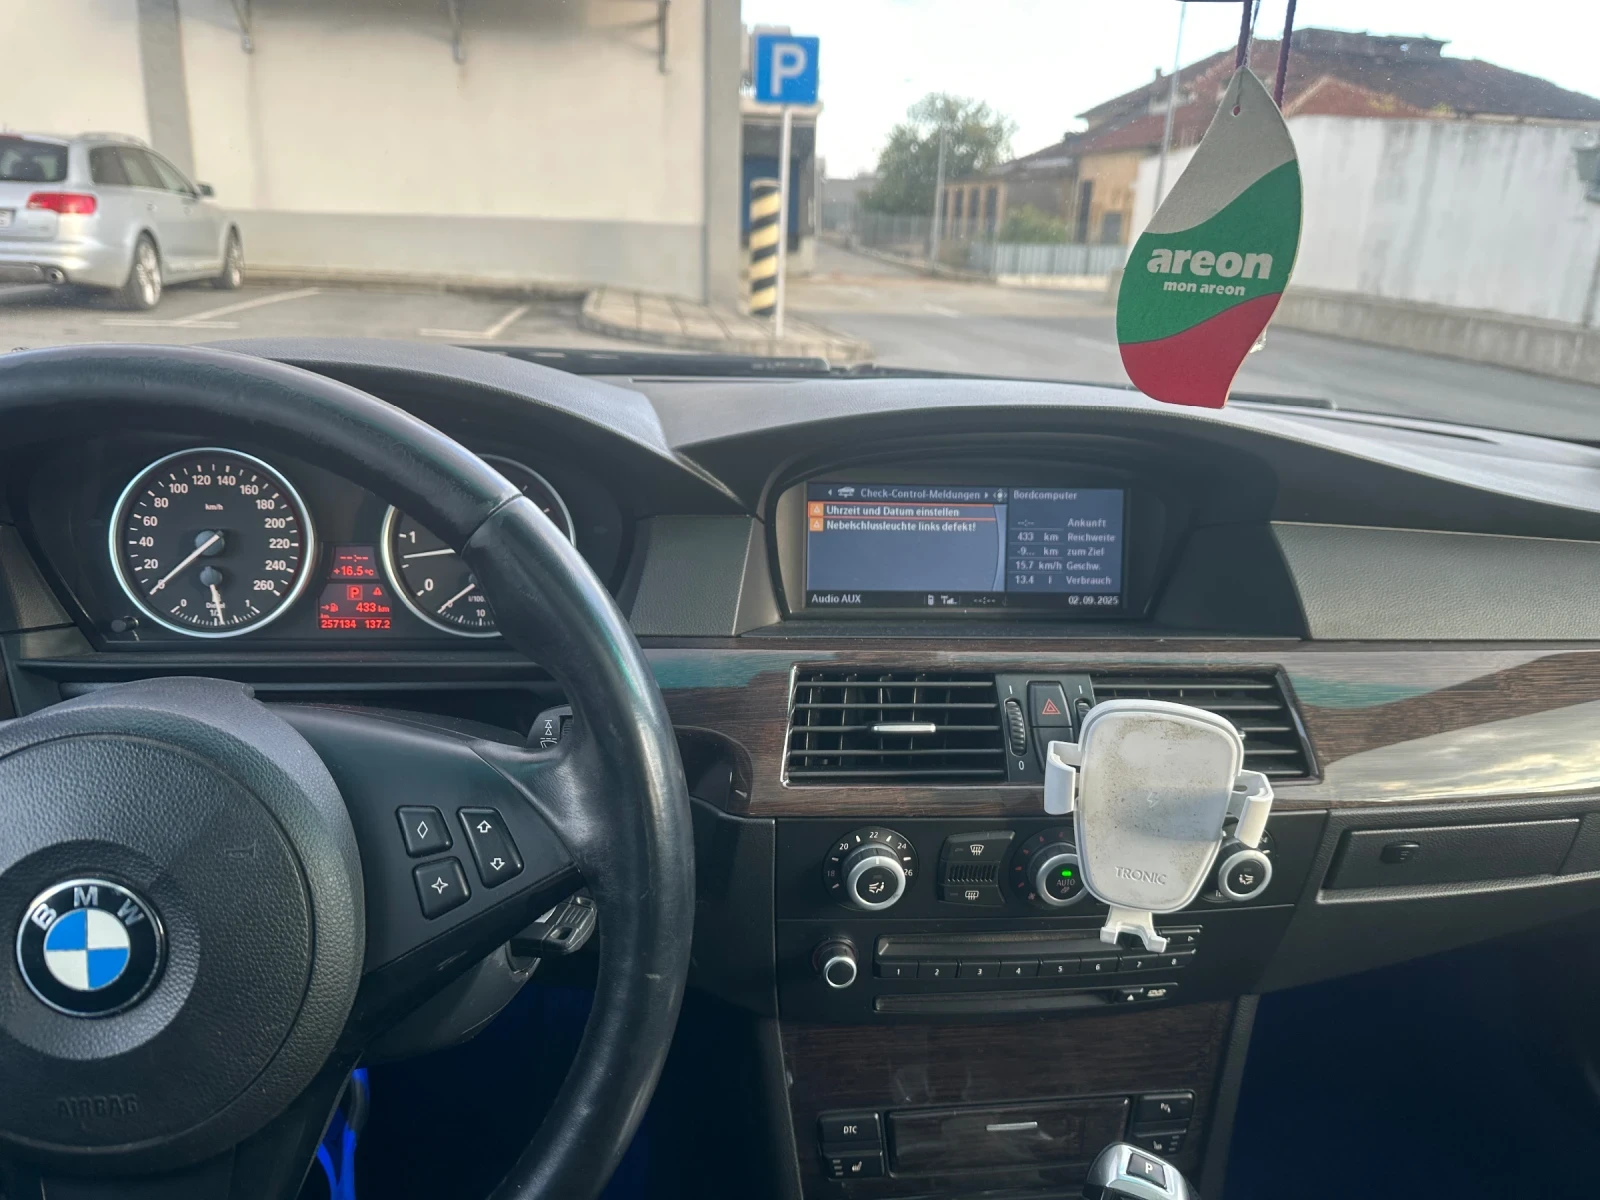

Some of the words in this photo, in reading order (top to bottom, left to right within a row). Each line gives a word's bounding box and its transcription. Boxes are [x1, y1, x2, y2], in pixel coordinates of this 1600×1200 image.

[770, 43, 807, 96] P
[1146, 248, 1273, 280] areon
[1163, 280, 1196, 292] mon
[1199, 283, 1246, 296] areon
[192, 475, 211, 486] 120
[216, 475, 236, 486] 140
[169, 483, 188, 494] 100
[239, 484, 259, 495] 160
[860, 488, 981, 500] Check-Control-Meldungen
[1013, 489, 1078, 502] Bordcomputer
[154, 497, 169, 508] 80
[255, 499, 275, 510] 180
[826, 505, 861, 516] Uhrzeit
[863, 506, 881, 516] und
[883, 506, 916, 516] Datum
[917, 506, 960, 517] einstellen
[143, 516, 158, 527] 60
[264, 518, 285, 529] 200
[826, 520, 916, 531] Nebelschlussleuchte
[918, 521, 940, 531] links
[942, 521, 977, 532] defekt!
[1067, 518, 1107, 528] Ankunft
[139, 536, 154, 547] 40
[409, 531, 416, 543] 1
[1017, 532, 1034, 542] 433
[1043, 532, 1059, 541] km
[1067, 532, 1116, 542] Reichweite
[269, 538, 290, 549] 220
[1043, 547, 1059, 556] km
[1087, 547, 1105, 557] Ziel
[144, 558, 158, 569] 20
[265, 560, 286, 571] 240
[1038, 561, 1062, 570] km/h
[1066, 561, 1101, 571] Geschw.
[253, 580, 275, 591] 260
[424, 578, 434, 591] 0
[1015, 575, 1034, 584] 13.4
[1066, 575, 1112, 585] Verbrauch
[349, 587, 360, 599] P
[811, 594, 840, 603] Audio
[841, 594, 861, 603] AUX
[180, 599, 187, 607] 0
[245, 599, 250, 607] 1
[1068, 595, 1119, 605] 02.09.2025
[356, 602, 377, 612] 433
[476, 609, 486, 617] 10
[321, 619, 356, 629] 257134
[365, 619, 391, 629] 137.2
[869, 831, 879, 839] 22
[897, 842, 907, 850] 24
[904, 868, 913, 876] 26
[1114, 866, 1167, 886] TRONIC
[1056, 878, 1076, 886] AUTO
[31, 886, 145, 931] BMW
[934, 968, 940, 976] 2
[1015, 967, 1021, 975] 4
[1058, 965, 1063, 973] 5
[1095, 963, 1100, 971] 6
[56, 1093, 139, 1119] AIRBAG
[843, 1125, 858, 1134] DTC
[1145, 1162, 1154, 1174] P
